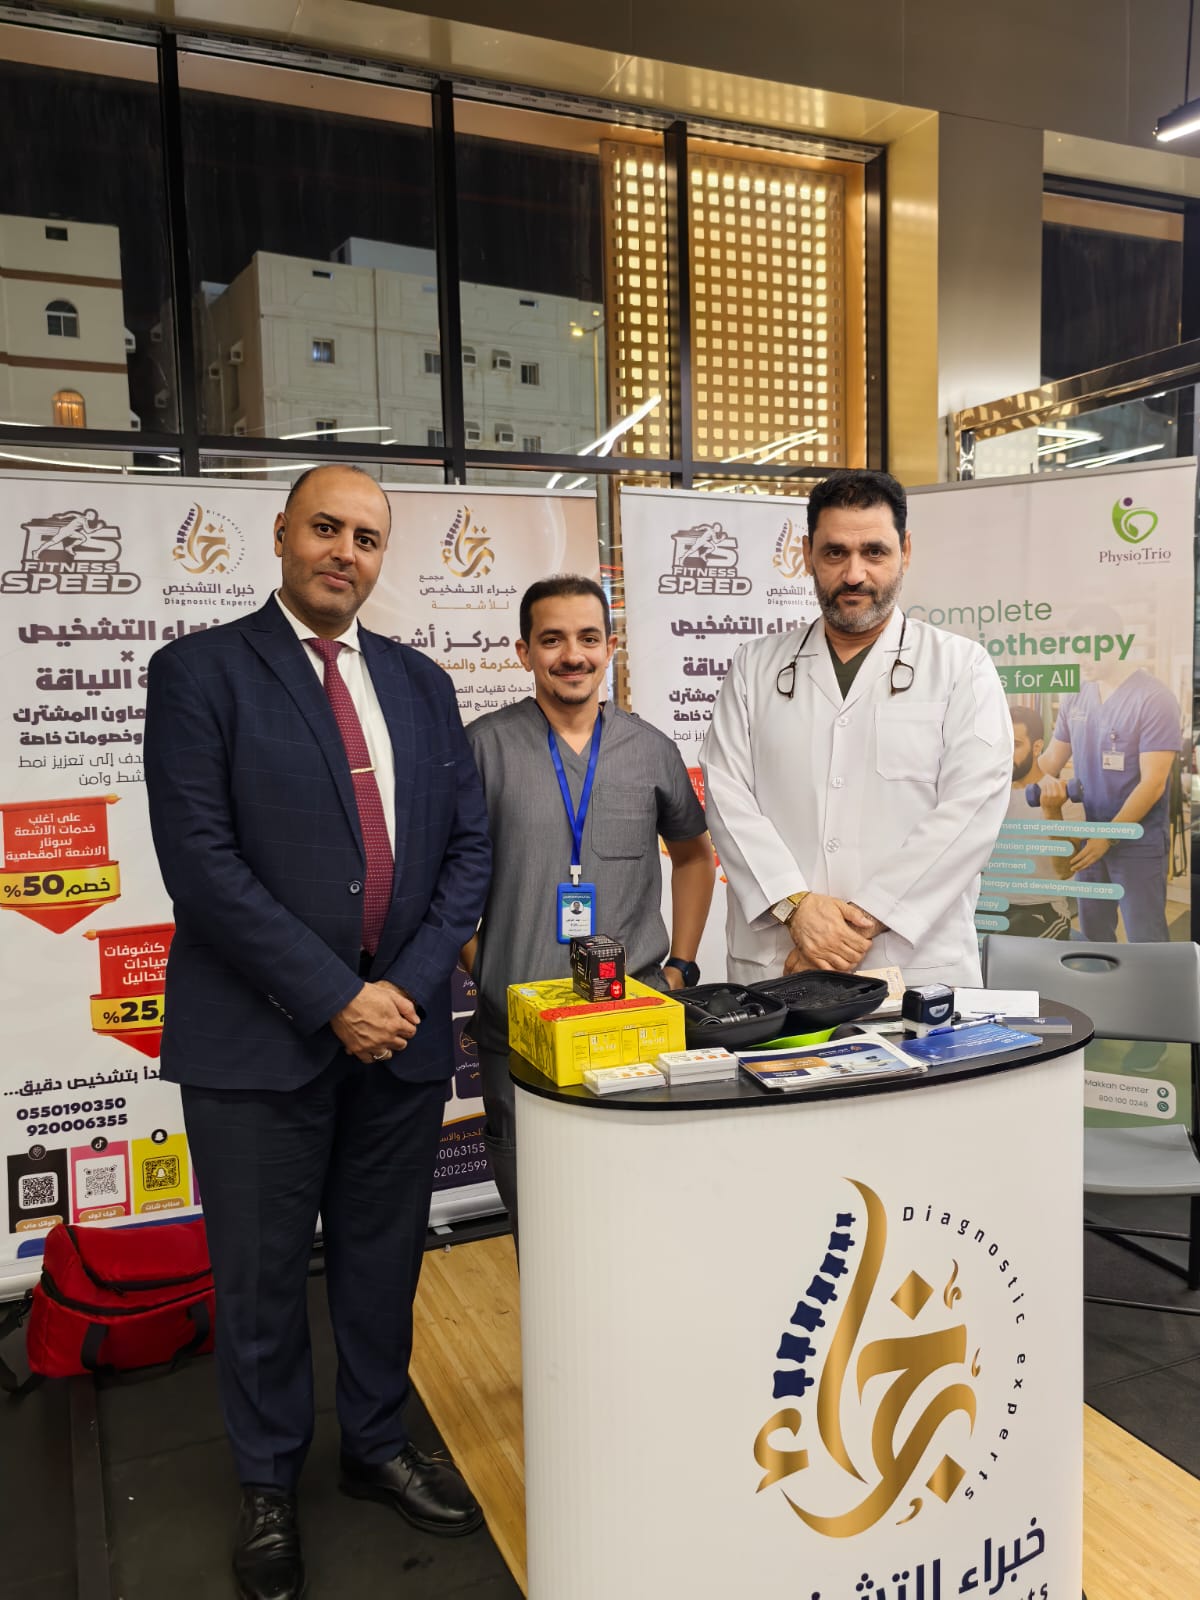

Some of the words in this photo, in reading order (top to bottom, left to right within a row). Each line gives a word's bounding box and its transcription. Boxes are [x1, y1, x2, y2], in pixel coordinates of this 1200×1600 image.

[24, 561, 119, 573] FITNESS
[673, 567, 736, 578] FITNESS
[2, 572, 141, 594] SPEED
[162, 582, 221, 596] التشخيص
[225, 584, 255, 597] خبراء
[419, 584, 484, 596] التشخيص
[486, 584, 517, 596] خبراء
[658, 575, 752, 595] SPEED
[164, 597, 217, 606] Diagnostic
[220, 598, 257, 607] Experts
[905, 600, 1052, 630] Complete
[18, 617, 156, 647] التشخيص
[670, 614, 763, 640] التشخيص
[443, 630, 510, 652] مركز
[978, 633, 1135, 661] iotherapy
[480, 657, 523, 672] مكرمة
[682, 656, 732, 681] لياقة
[36, 667, 132, 696] اللياقة
[1014, 671, 1043, 687] for
[1050, 670, 1074, 687] All
[13, 705, 98, 725] المشترك
[673, 709, 701, 721] خاصة
[20, 731, 62, 745] خاصة
[65, 729, 143, 745] وخصومات
[18, 755, 47, 768] نمط
[52, 754, 84, 769] تعزيز
[89, 753, 114, 767] إلى
[116, 769, 147, 783] شط
[57, 813, 81, 824] على
[59, 823, 96, 834] خدمات
[1023, 822, 1039, 831] and
[1041, 824, 1095, 834] performance
[1097, 827, 1136, 836] recovery
[40, 837, 72, 849] سونار
[6, 848, 62, 862] المقطعية
[66, 877, 110, 898] خصم
[982, 879, 1010, 889] herapy
[1011, 880, 1028, 889] and
[1029, 881, 1092, 894] developmental
[1093, 886, 1113, 894] care
[104, 942, 165, 957] كشوفات
[68, 1070, 138, 1089] بتشخيص
[1119, 1084, 1150, 1094] Center
[16, 1097, 126, 1121] 0550190350
[27, 1113, 128, 1137] 920006355
[436, 1142, 486, 1160] 0063155
[433, 1159, 488, 1178] 62022599
[902, 1204, 1027, 1325] Diagnostic
[963, 1352, 1027, 1500] experts
[958, 1516, 1046, 1596] خبراء
